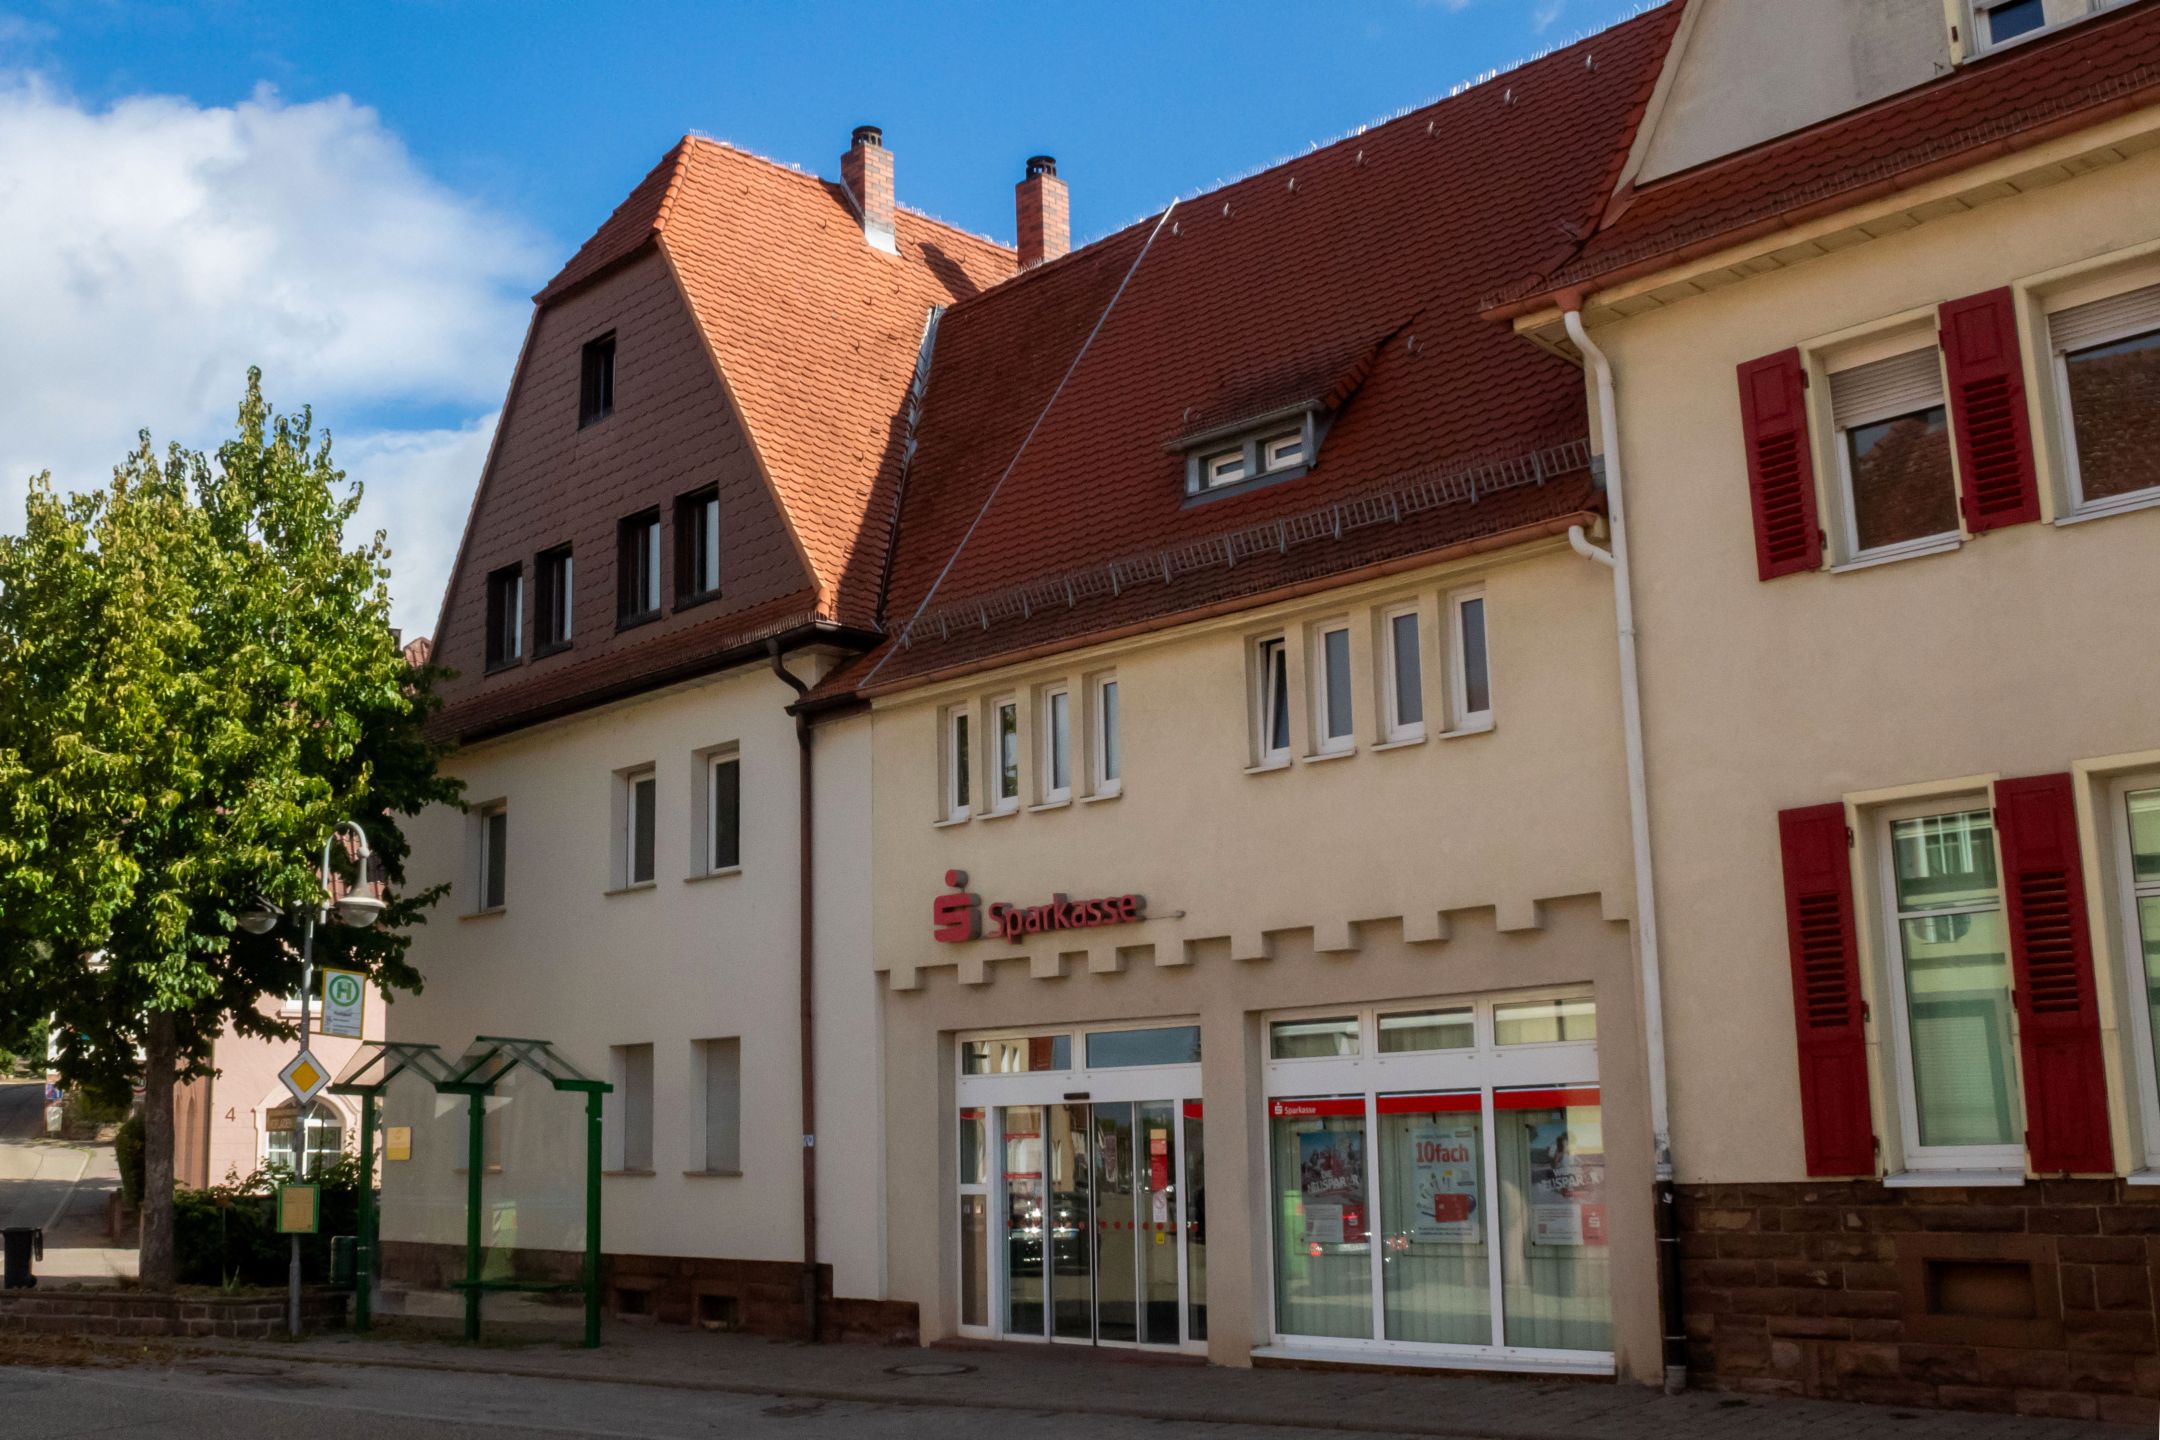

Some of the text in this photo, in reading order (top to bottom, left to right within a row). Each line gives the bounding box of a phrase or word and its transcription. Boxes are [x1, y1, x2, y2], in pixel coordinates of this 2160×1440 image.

[988, 893, 1142, 944] Sparkasse
[336, 982, 353, 1001] H
[225, 1107, 236, 1122] 4
[1284, 1105, 1317, 1115] Sparkasse
[1415, 1140, 1470, 1163] 10fach
